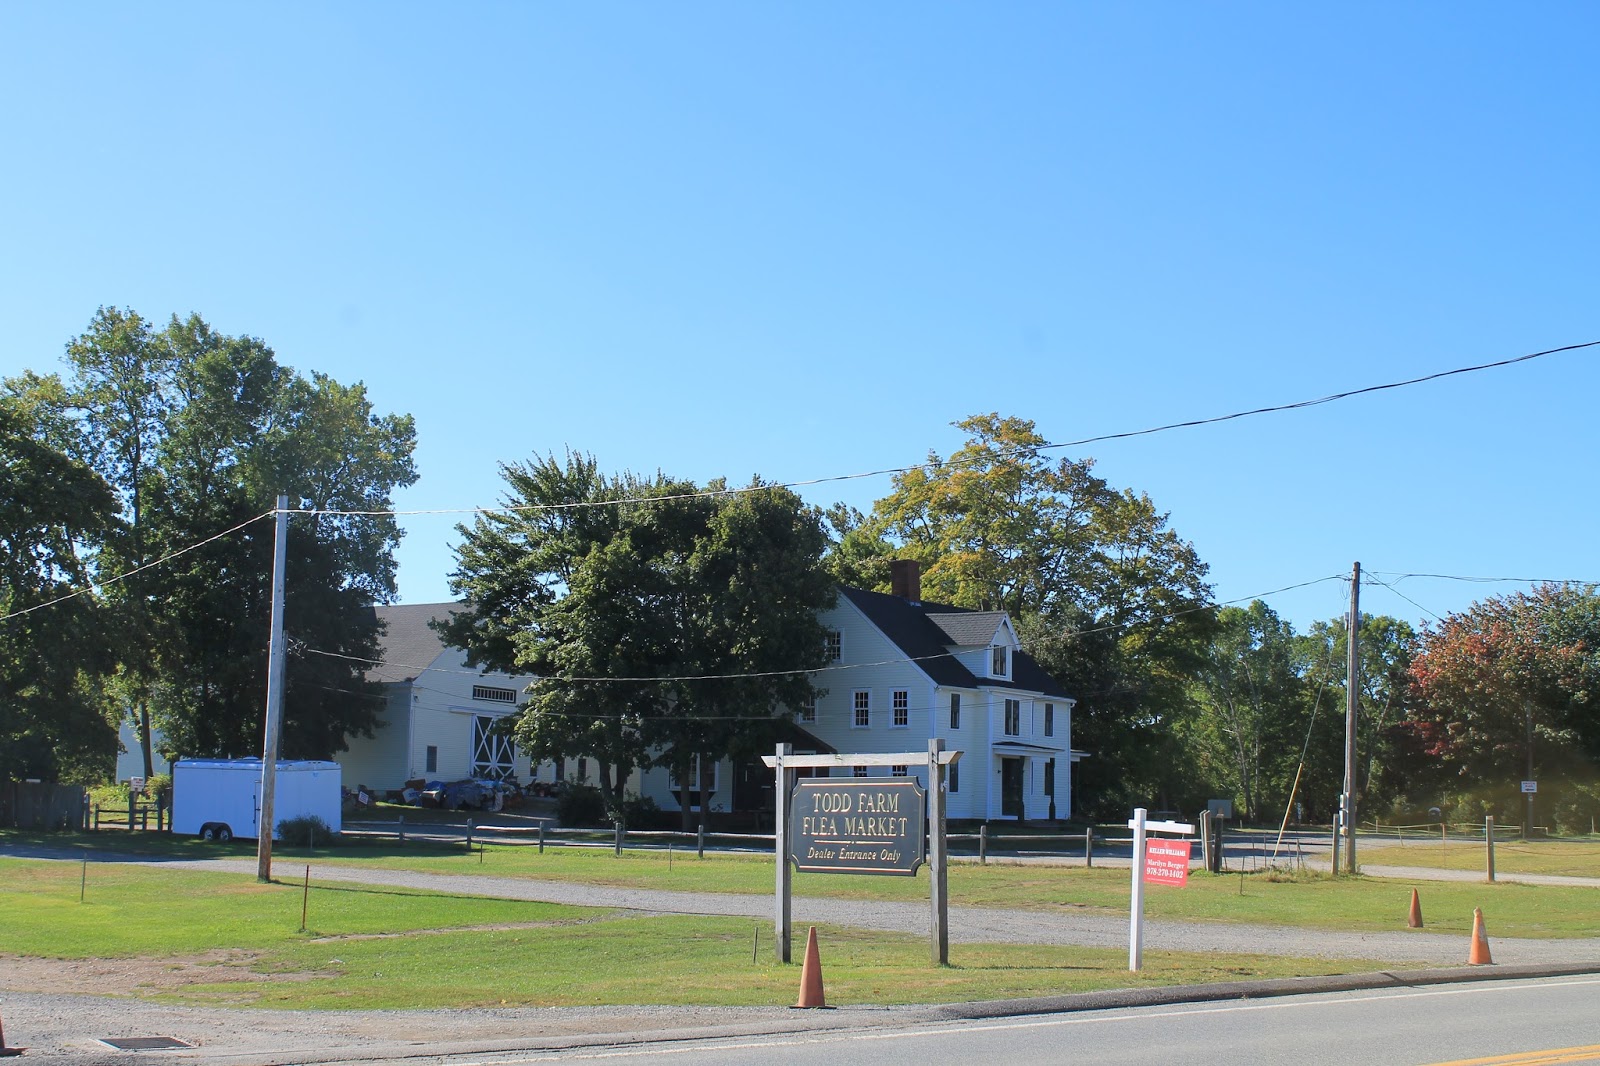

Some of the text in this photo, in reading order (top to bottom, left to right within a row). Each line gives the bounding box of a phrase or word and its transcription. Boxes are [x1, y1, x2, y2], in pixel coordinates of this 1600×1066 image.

[812, 792, 900, 813] TODD FARM
[802, 816, 908, 837] FLEA MARKET
[807, 846, 901, 864] Dealer Entrance Only
